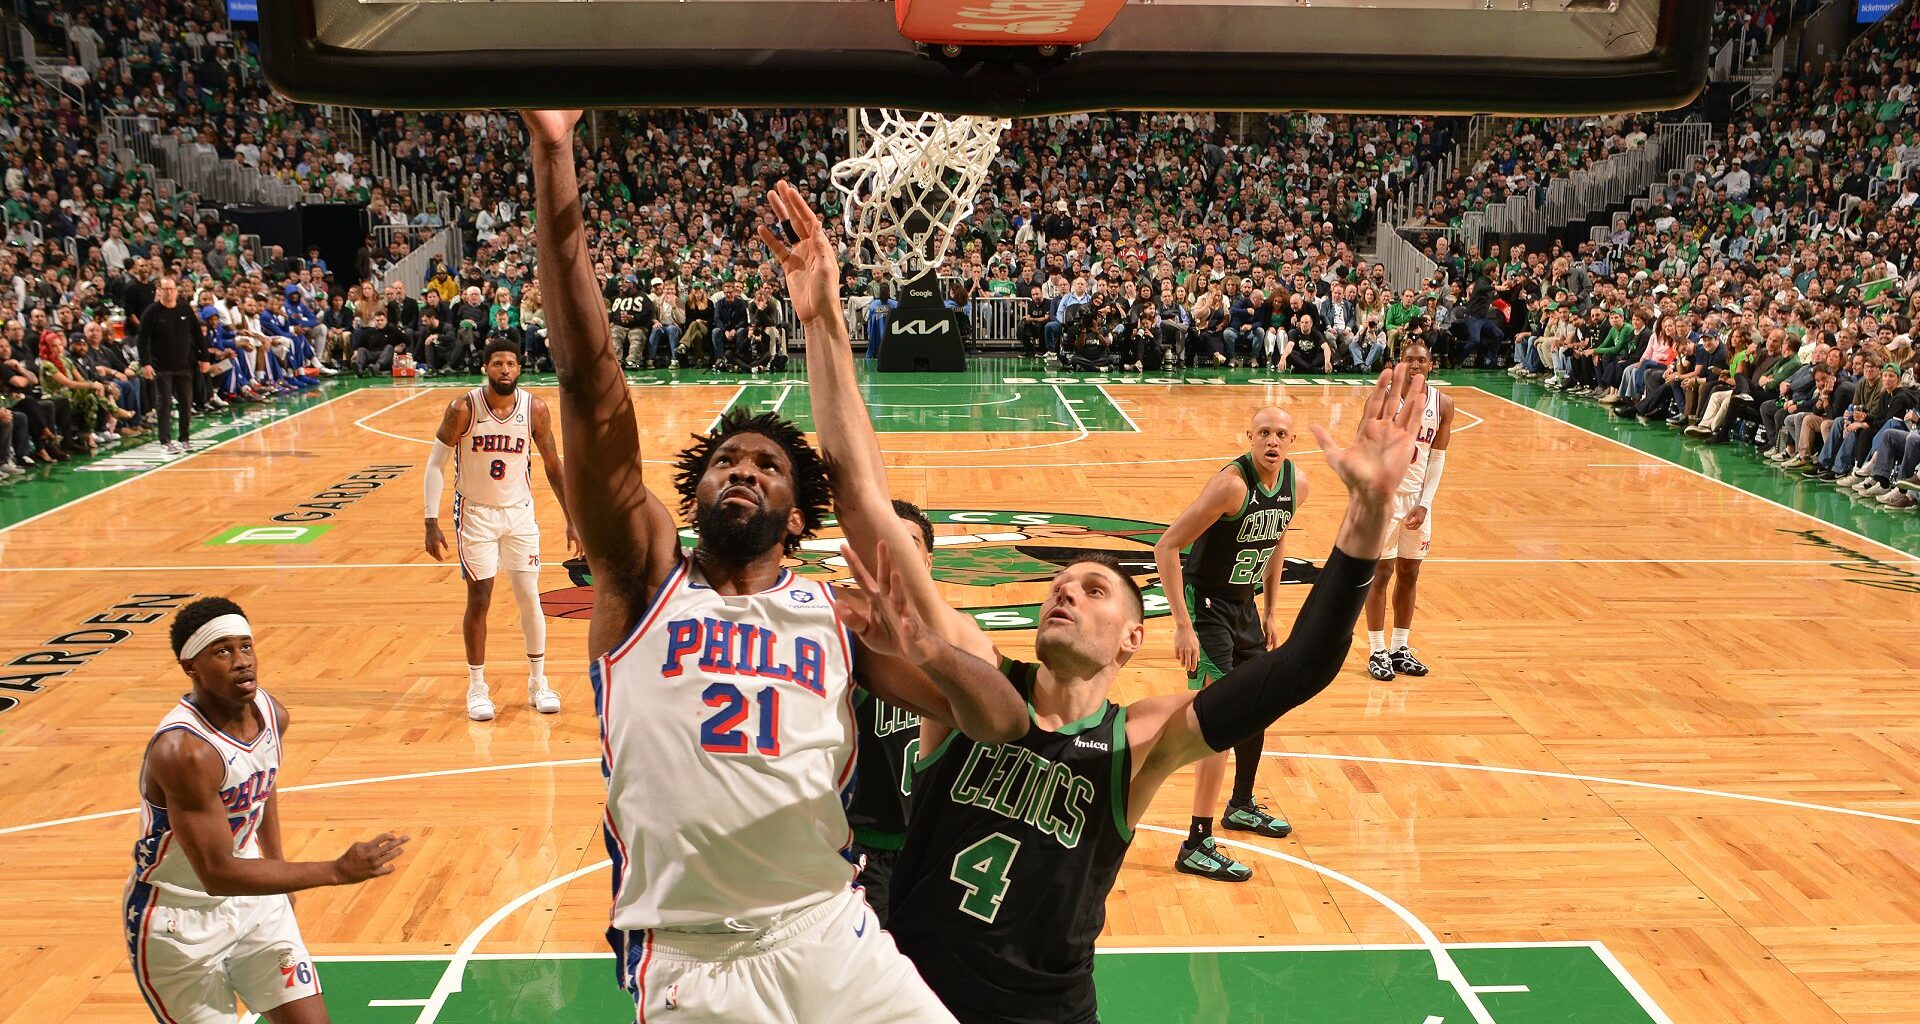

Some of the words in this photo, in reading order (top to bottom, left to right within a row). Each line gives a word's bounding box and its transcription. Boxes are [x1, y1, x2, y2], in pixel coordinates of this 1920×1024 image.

[611, 296, 644, 312] BOS
[909, 289, 933, 298] Google
[891, 319, 950, 335] KIA
[1002, 377, 1226, 385] BOSTON
[471, 434, 525, 454] PHILA
[490, 459, 506, 480] 8
[269, 464, 415, 522] GARDEN
[1236, 508, 1291, 542] CELTICS
[661, 616, 827, 700] PHILA
[700, 682, 780, 757] 21
[950, 741, 1095, 849] CELTICS
[949, 831, 1021, 924] 4
[280, 961, 312, 989] 76
